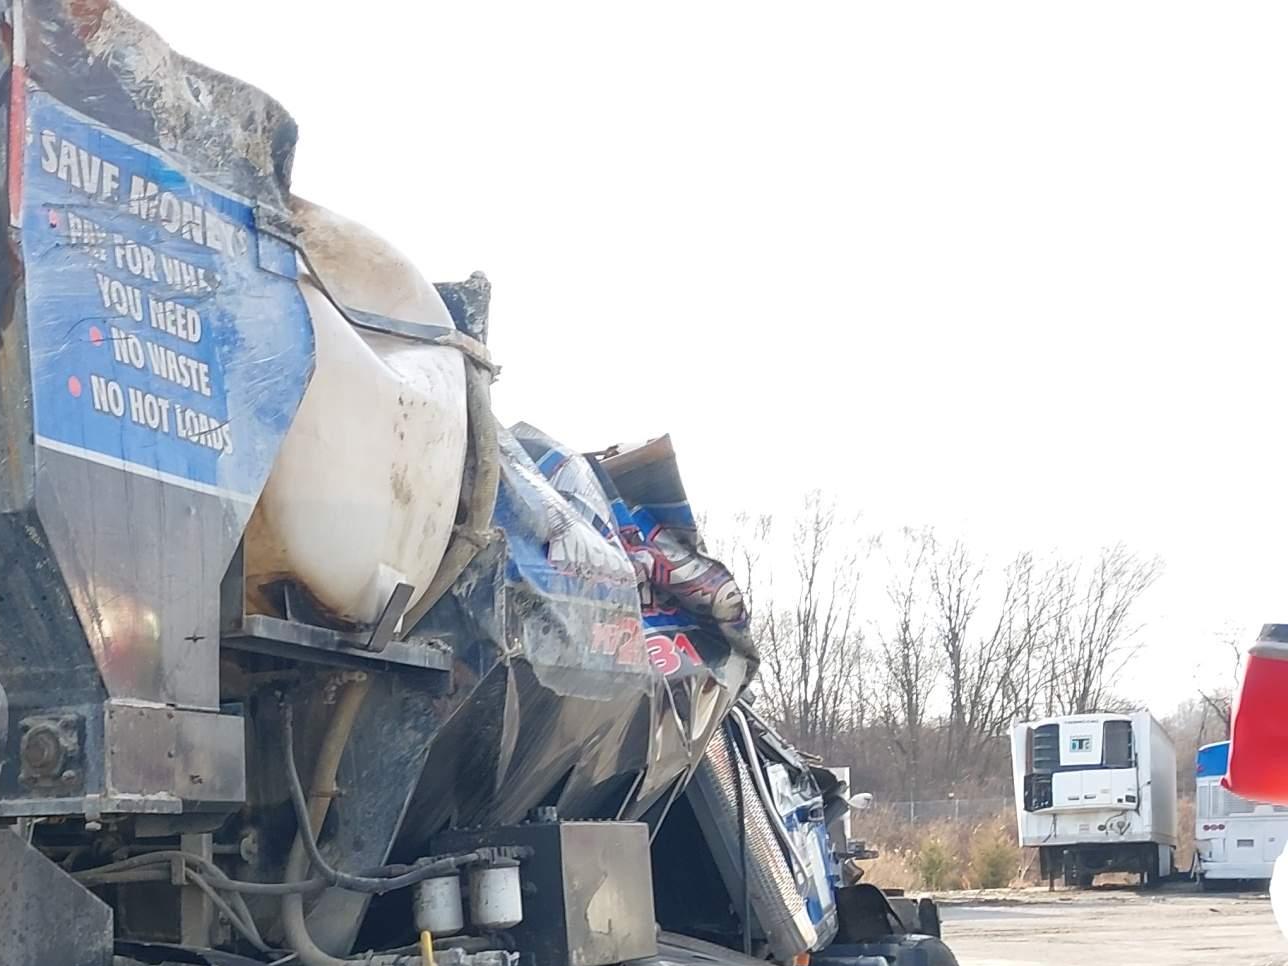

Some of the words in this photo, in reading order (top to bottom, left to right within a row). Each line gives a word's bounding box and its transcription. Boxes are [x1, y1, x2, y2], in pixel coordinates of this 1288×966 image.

[41, 129, 120, 201] SAVE
[114, 233, 159, 282] FOR
[160, 253, 221, 292] WHA
[96, 272, 144, 322] YOU
[148, 294, 202, 343] NEED
[112, 326, 145, 369] NO
[146, 341, 211, 397] WASTE
[90, 374, 125, 417] NO
[128, 387, 170, 433] HOT
[174, 403, 233, 454] LOADS
